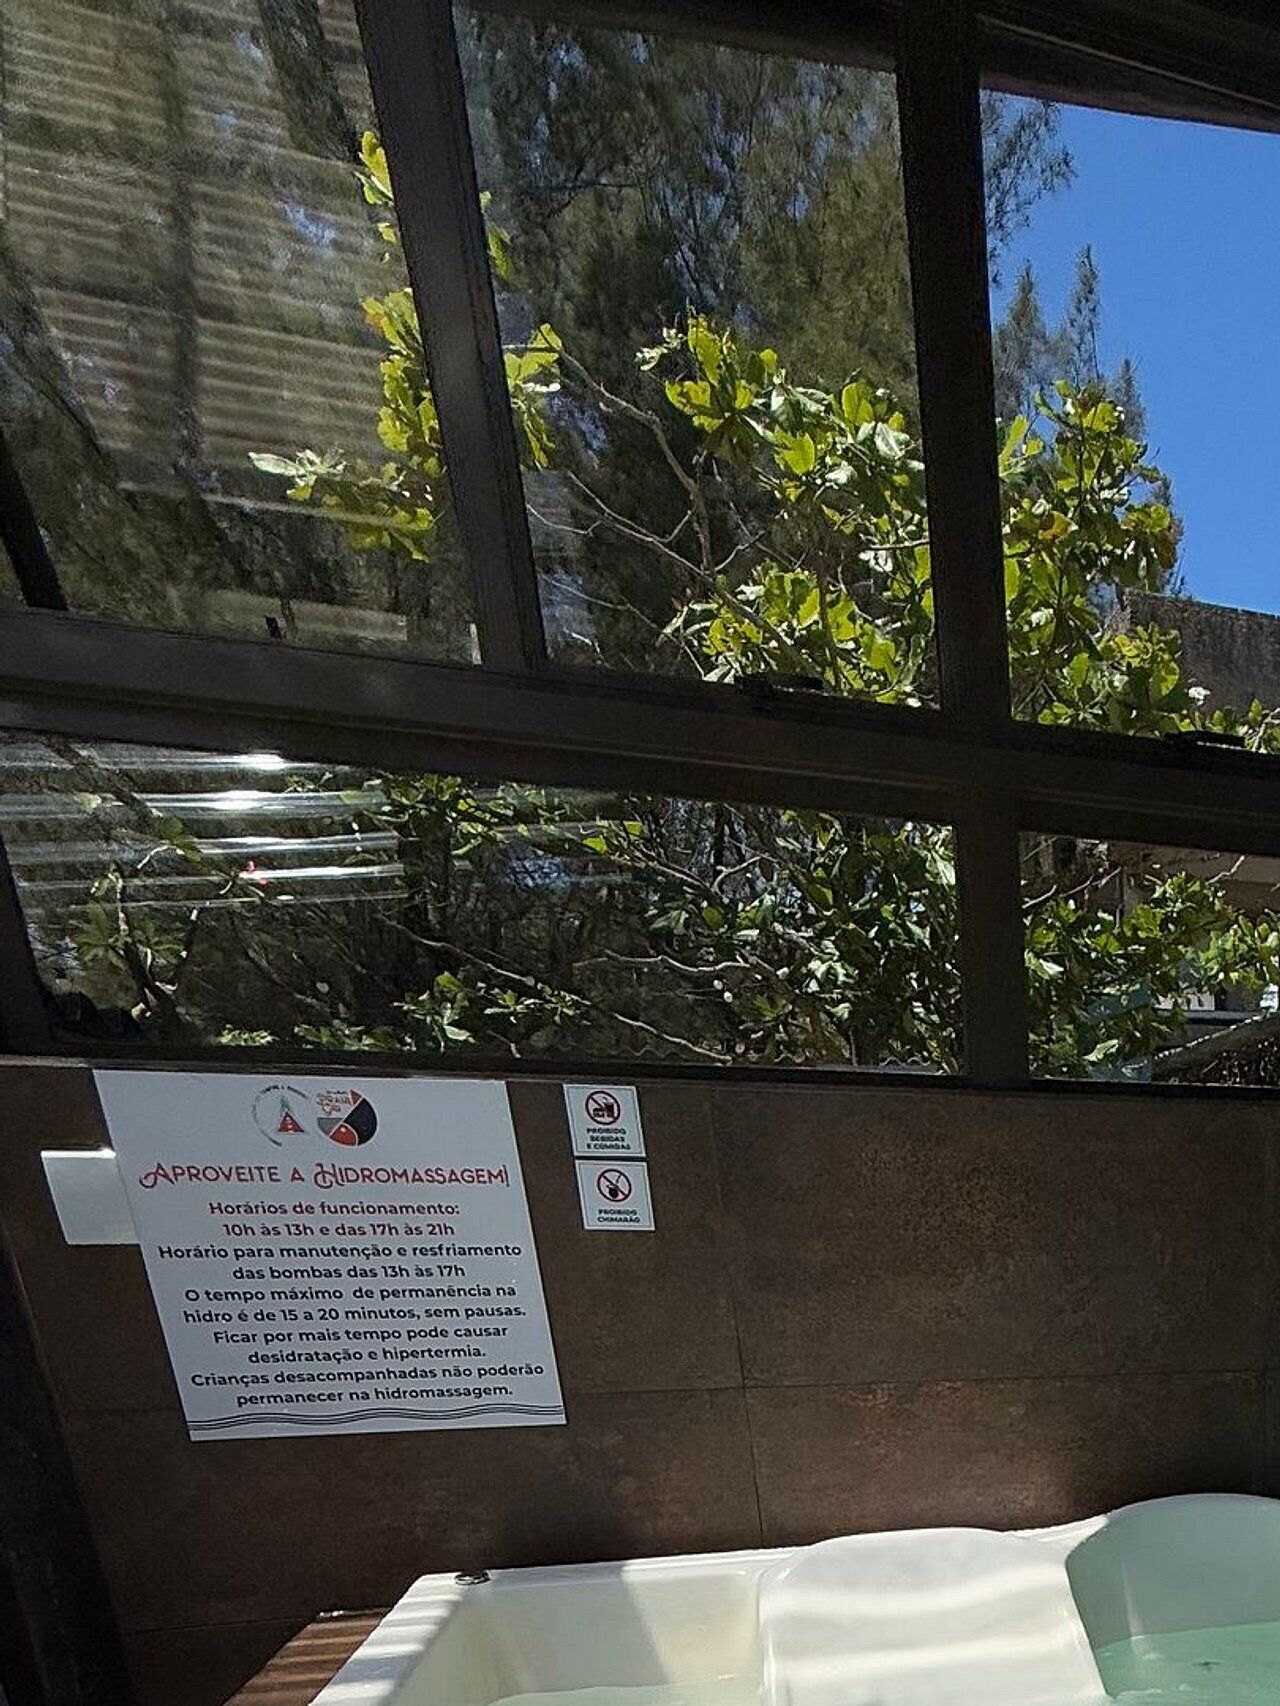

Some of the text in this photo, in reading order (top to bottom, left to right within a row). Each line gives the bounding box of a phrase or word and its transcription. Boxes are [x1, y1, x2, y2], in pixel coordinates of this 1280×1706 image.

[290, 1167, 304, 1182] A
[209, 1201, 460, 1216] Horários de funcionamento:
[222, 1222, 455, 1237] 10h às 13h e das 17h às 21h
[158, 1243, 522, 1262] Horário para manutenção e resfriamento
[232, 1264, 466, 1280] das bombas das 13h às 17h
[184, 1284, 517, 1304] O tempo máximo de permanência na
[184, 1306, 526, 1323] hidro é de 15 a 20 minutos, sem pausas.
[213, 1326, 509, 1346] Ficar por mais tempo pode causar
[248, 1344, 486, 1365] desidratação e hipertermia.
[190, 1363, 545, 1388] Crianças desacompanhadas não poderão
[236, 1384, 514, 1408] permanecer na hidromassagem.
